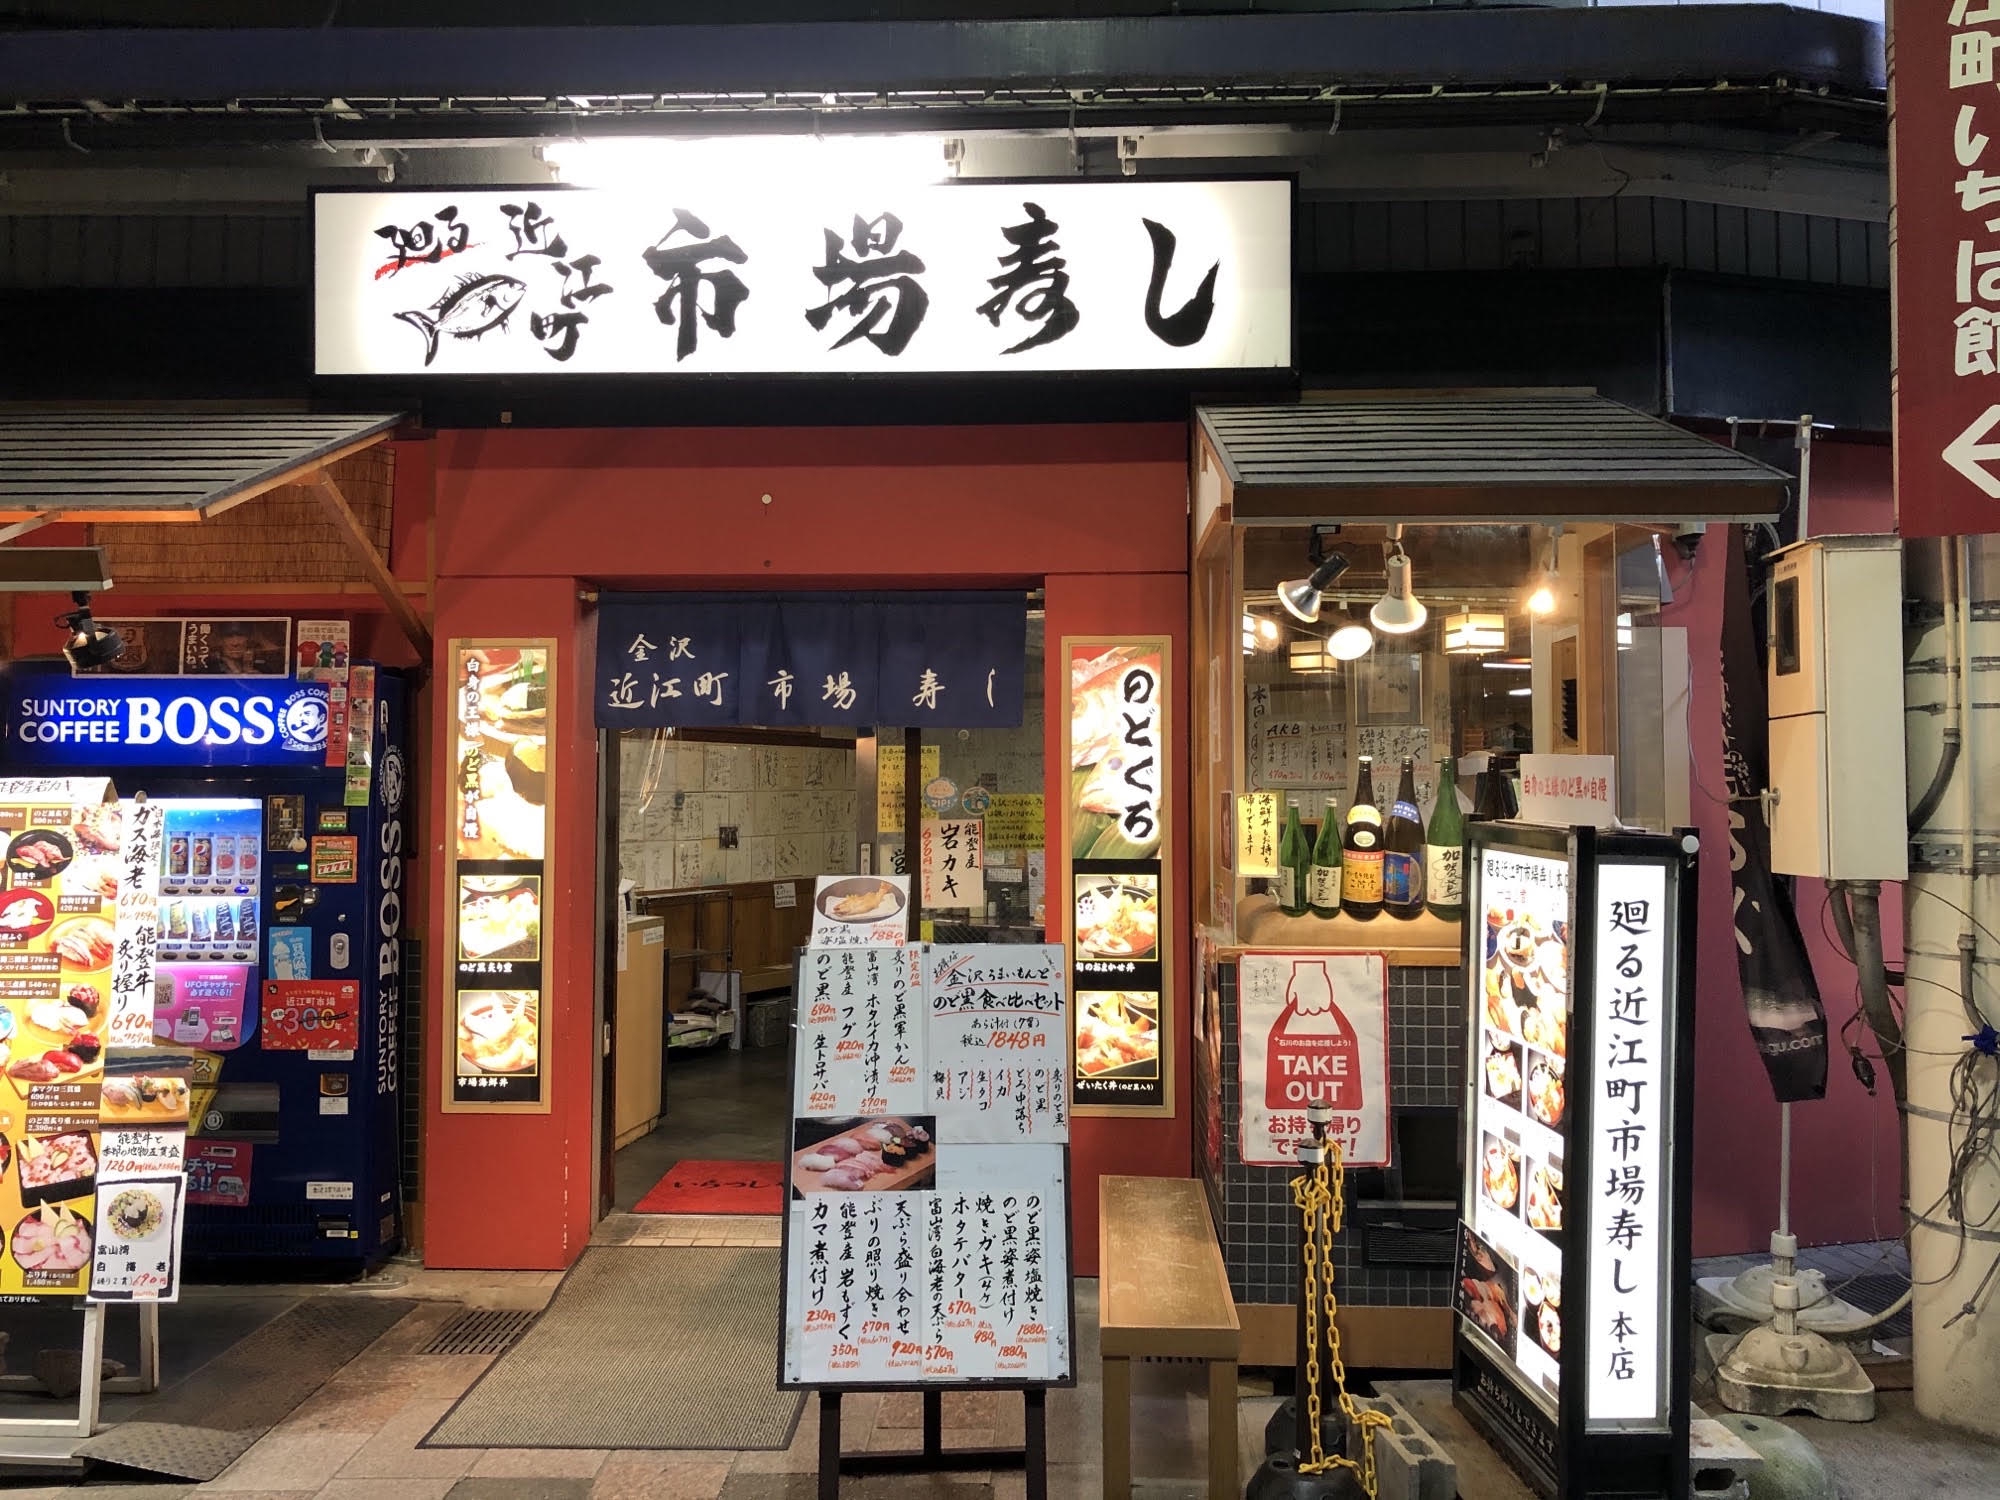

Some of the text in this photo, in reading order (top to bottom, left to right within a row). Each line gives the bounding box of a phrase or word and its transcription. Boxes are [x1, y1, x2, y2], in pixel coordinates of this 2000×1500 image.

[374, 206, 471, 278] 廻る
[500, 201, 613, 362] 近江町
[642, 202, 1220, 362] 市場寿し
[628, 633, 696, 662] 金沢
[22, 699, 121, 717] SUNTORY
[307, 688, 329, 700] COFF
[20, 721, 120, 743] COFFEE
[125, 696, 275, 745] BOSS
[940, 823, 960, 898] 岩カキ
[964, 822, 979, 869] 能登産
[379, 819, 402, 981] BOSS
[134, 925, 156, 998] 能登牛
[814, 953, 831, 1002] のど黒
[286, 996, 336, 1006] 近江町市場
[933, 987, 1064, 1012] のど黒食べ比べセット
[377, 990, 389, 1094] SUNTORY
[388, 984, 400, 1092] COFFEE
[957, 1070, 971, 1100] アジ
[996, 1068, 1007, 1098] イカ
[1277, 1055, 1348, 1076] TAKE
[976, 1069, 989, 1111] 生タコ
[1285, 1081, 1344, 1102] OUT
[1268, 1115, 1361, 1135] お持帰り
[1604, 899, 1652, 1380] 廻る近江町市場寿し 本店
[809, 1202, 829, 1306] カマ煮付け
[892, 1200, 914, 1335] 天ぷら盛り合わせ
[952, 1196, 971, 1299] ホタテバター
[999, 1196, 1019, 1327] のど黒姿煮付け
[1024, 1195, 1043, 1322] のど黒姿塩焼き
[807, 1309, 836, 1322] 230円
[862, 1321, 890, 1334] 570円
[948, 1300, 976, 1315] 570円
[891, 1340, 923, 1357] 920円
[925, 1345, 954, 1360] 570円
